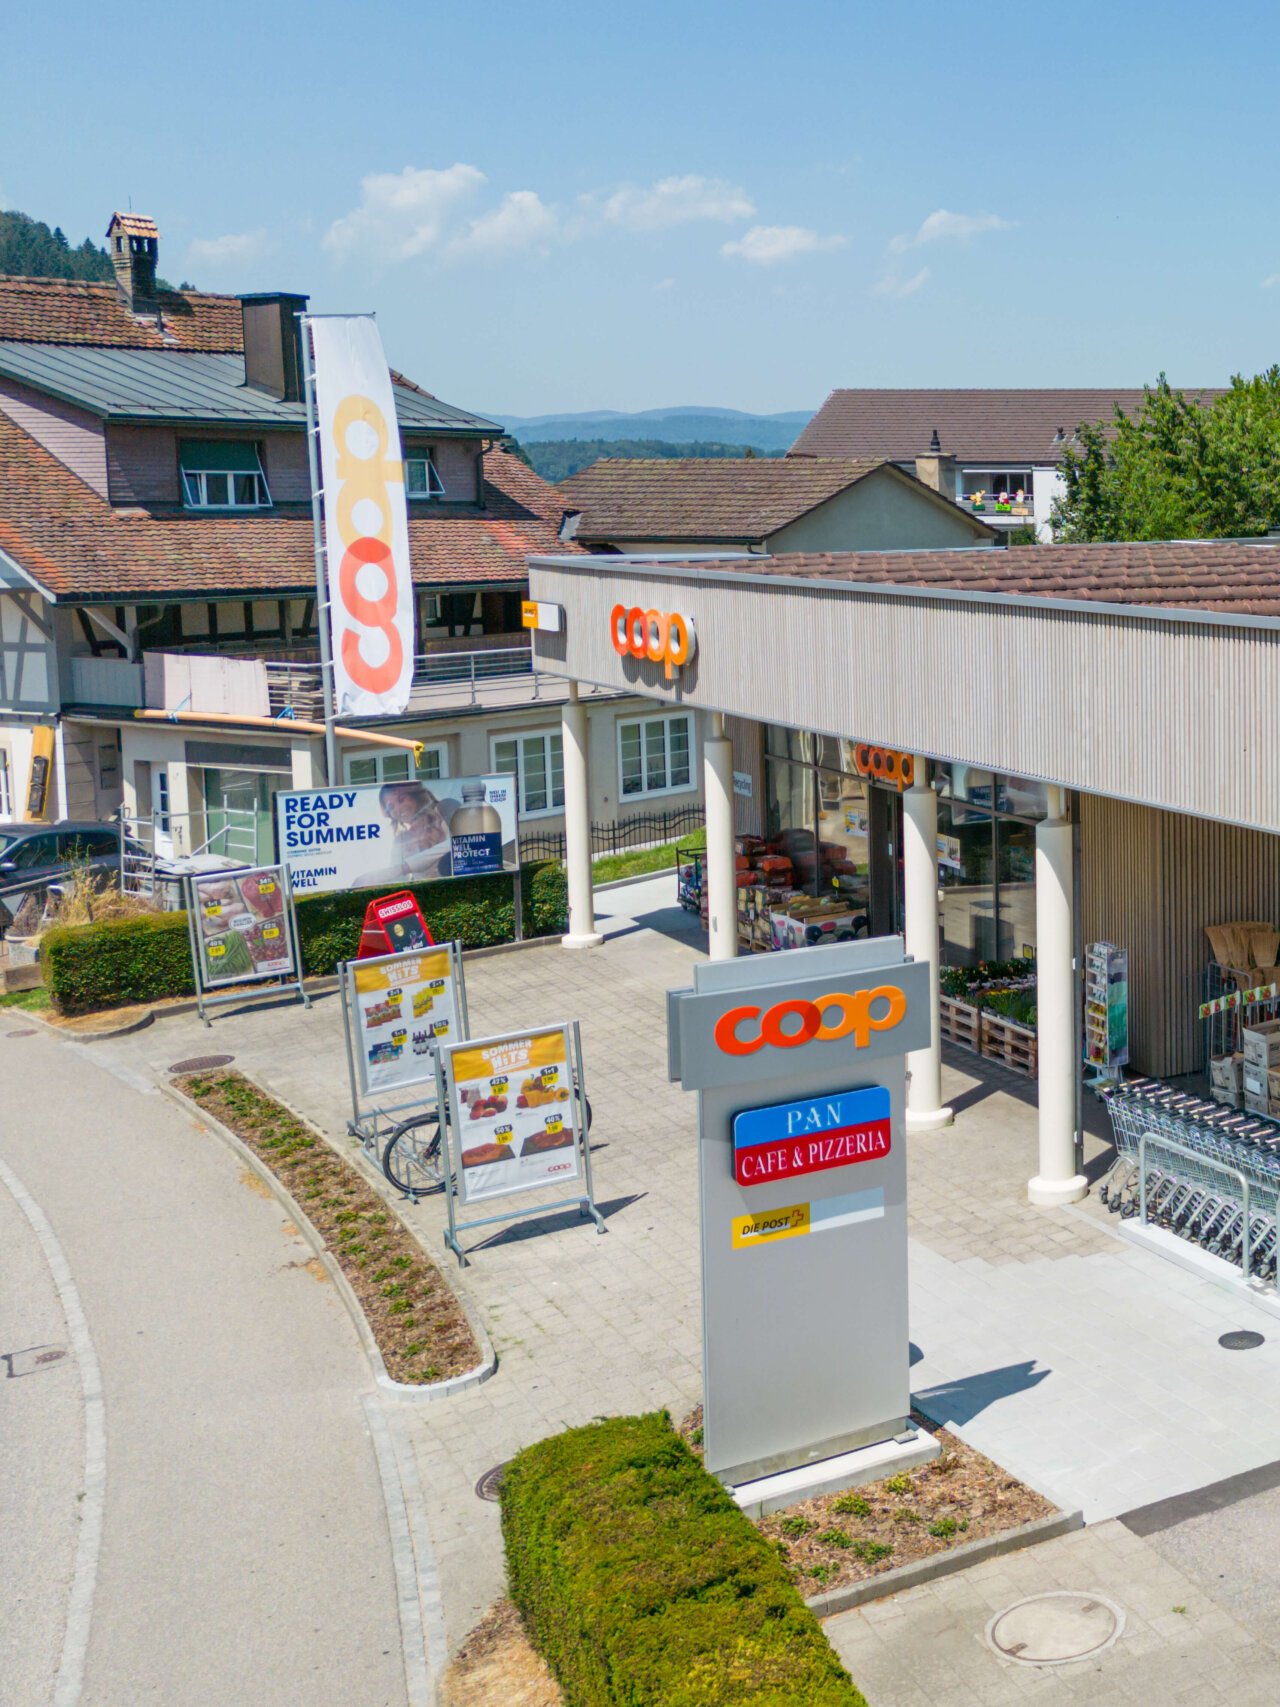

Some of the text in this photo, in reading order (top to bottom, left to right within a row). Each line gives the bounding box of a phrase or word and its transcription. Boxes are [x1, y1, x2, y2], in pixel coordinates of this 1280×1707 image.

[332, 394, 404, 694] coop
[611, 603, 693, 680] coop
[855, 743, 914, 793] coop
[285, 792, 358, 814] READY
[286, 811, 330, 830] FOR
[286, 823, 381, 848] SUMMER
[452, 834, 486, 845] VITAMIN
[453, 843, 472, 852] WELL
[453, 848, 491, 859] PROTECT
[379, 901, 413, 917] SWISSLOS
[714, 985, 907, 1056] coop
[481, 1039, 532, 1061] SOMMER
[788, 1102, 843, 1134] PAN
[741, 1130, 886, 1178] CAFE & PIZZERIA
[547, 1163, 572, 1173] coop
[742, 1216, 791, 1236] DIE POST
